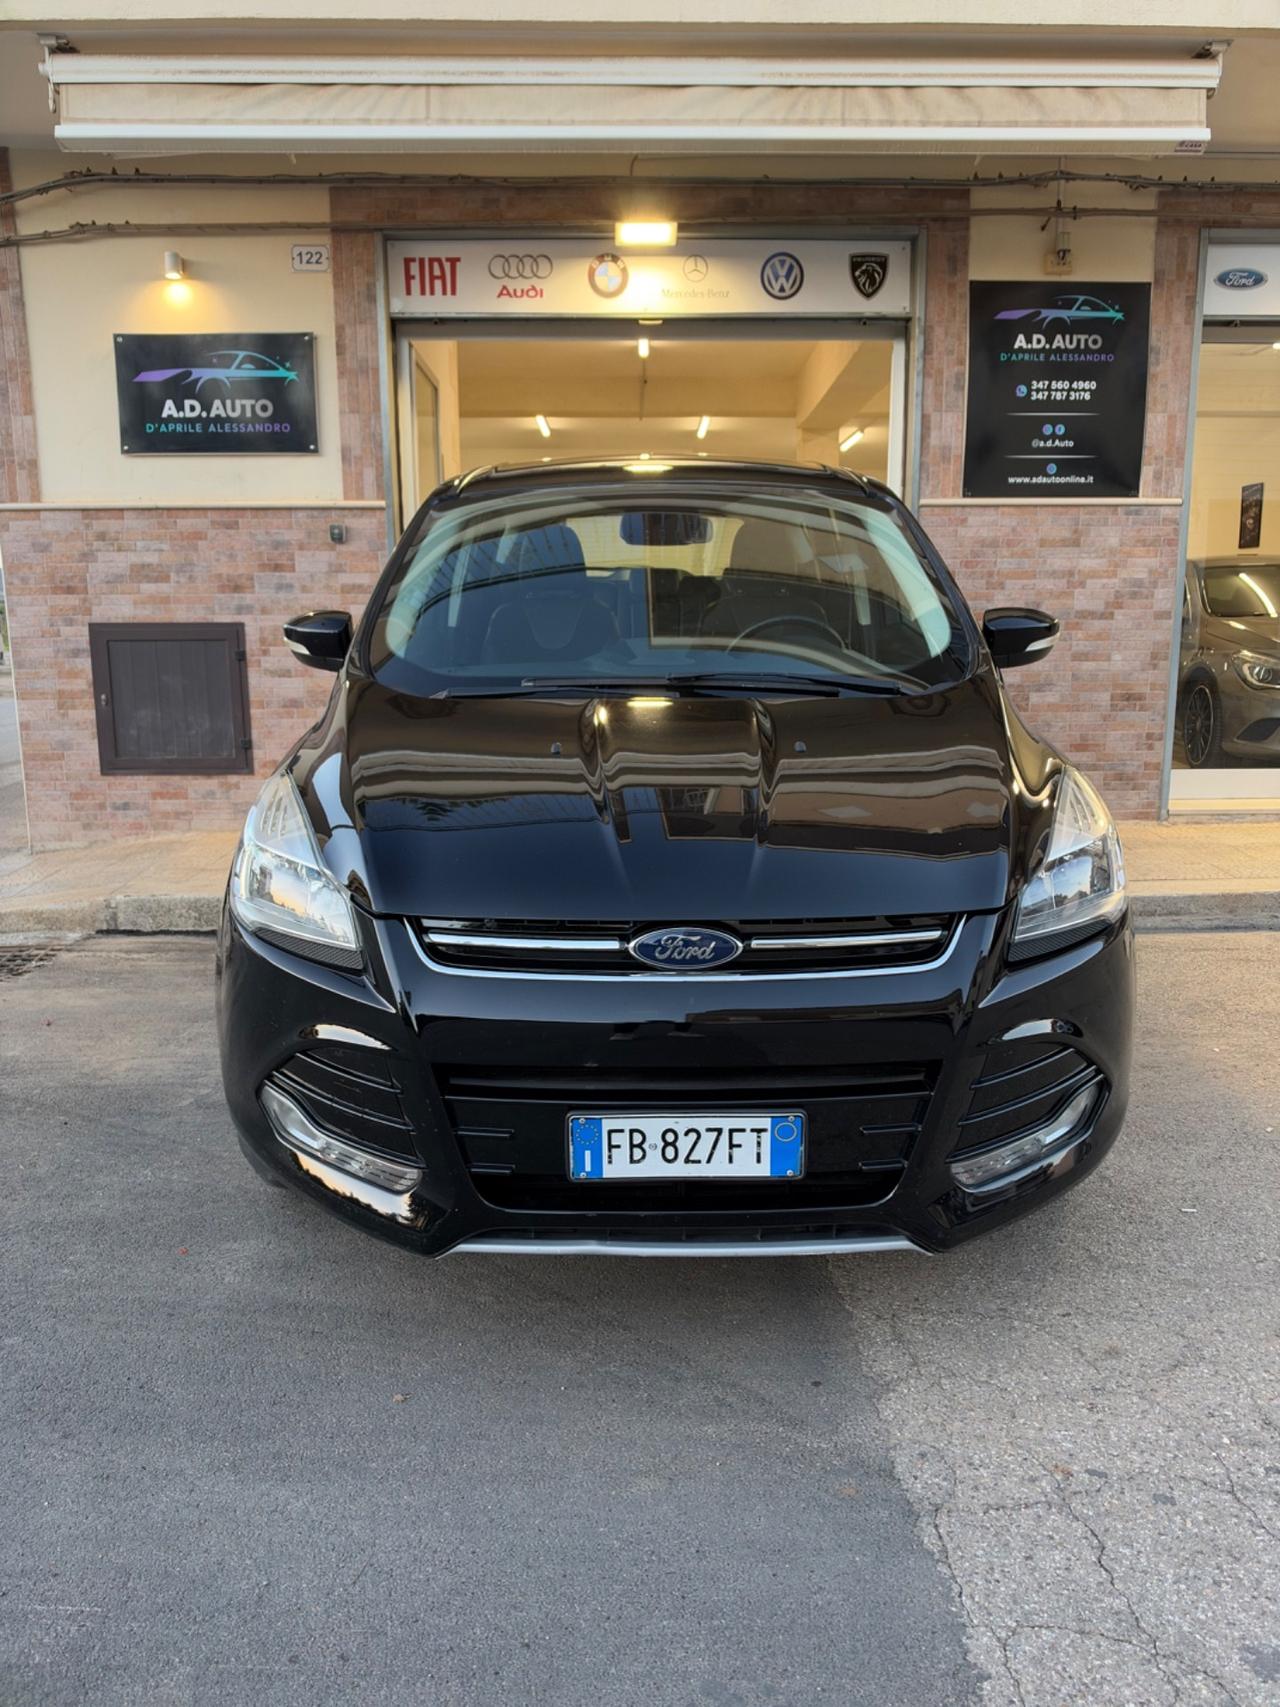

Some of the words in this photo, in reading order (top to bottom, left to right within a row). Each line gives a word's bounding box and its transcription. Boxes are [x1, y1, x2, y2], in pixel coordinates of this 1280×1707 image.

[296, 251, 323, 264] 122
[403, 257, 461, 296] FIAT
[1225, 271, 1256, 286] Ford
[497, 285, 544, 298] Audi
[1000, 352, 1045, 362] D'APRILE
[1050, 353, 1115, 362] ALESSANDRO
[1031, 380, 1049, 390] 347
[1030, 391, 1048, 401] 347
[1050, 391, 1068, 401] 787
[1069, 391, 1091, 401] 3176
[146, 423, 202, 433] D'APRILE
[208, 423, 290, 433] ALESSANDRO
[655, 934, 717, 960] Ford
